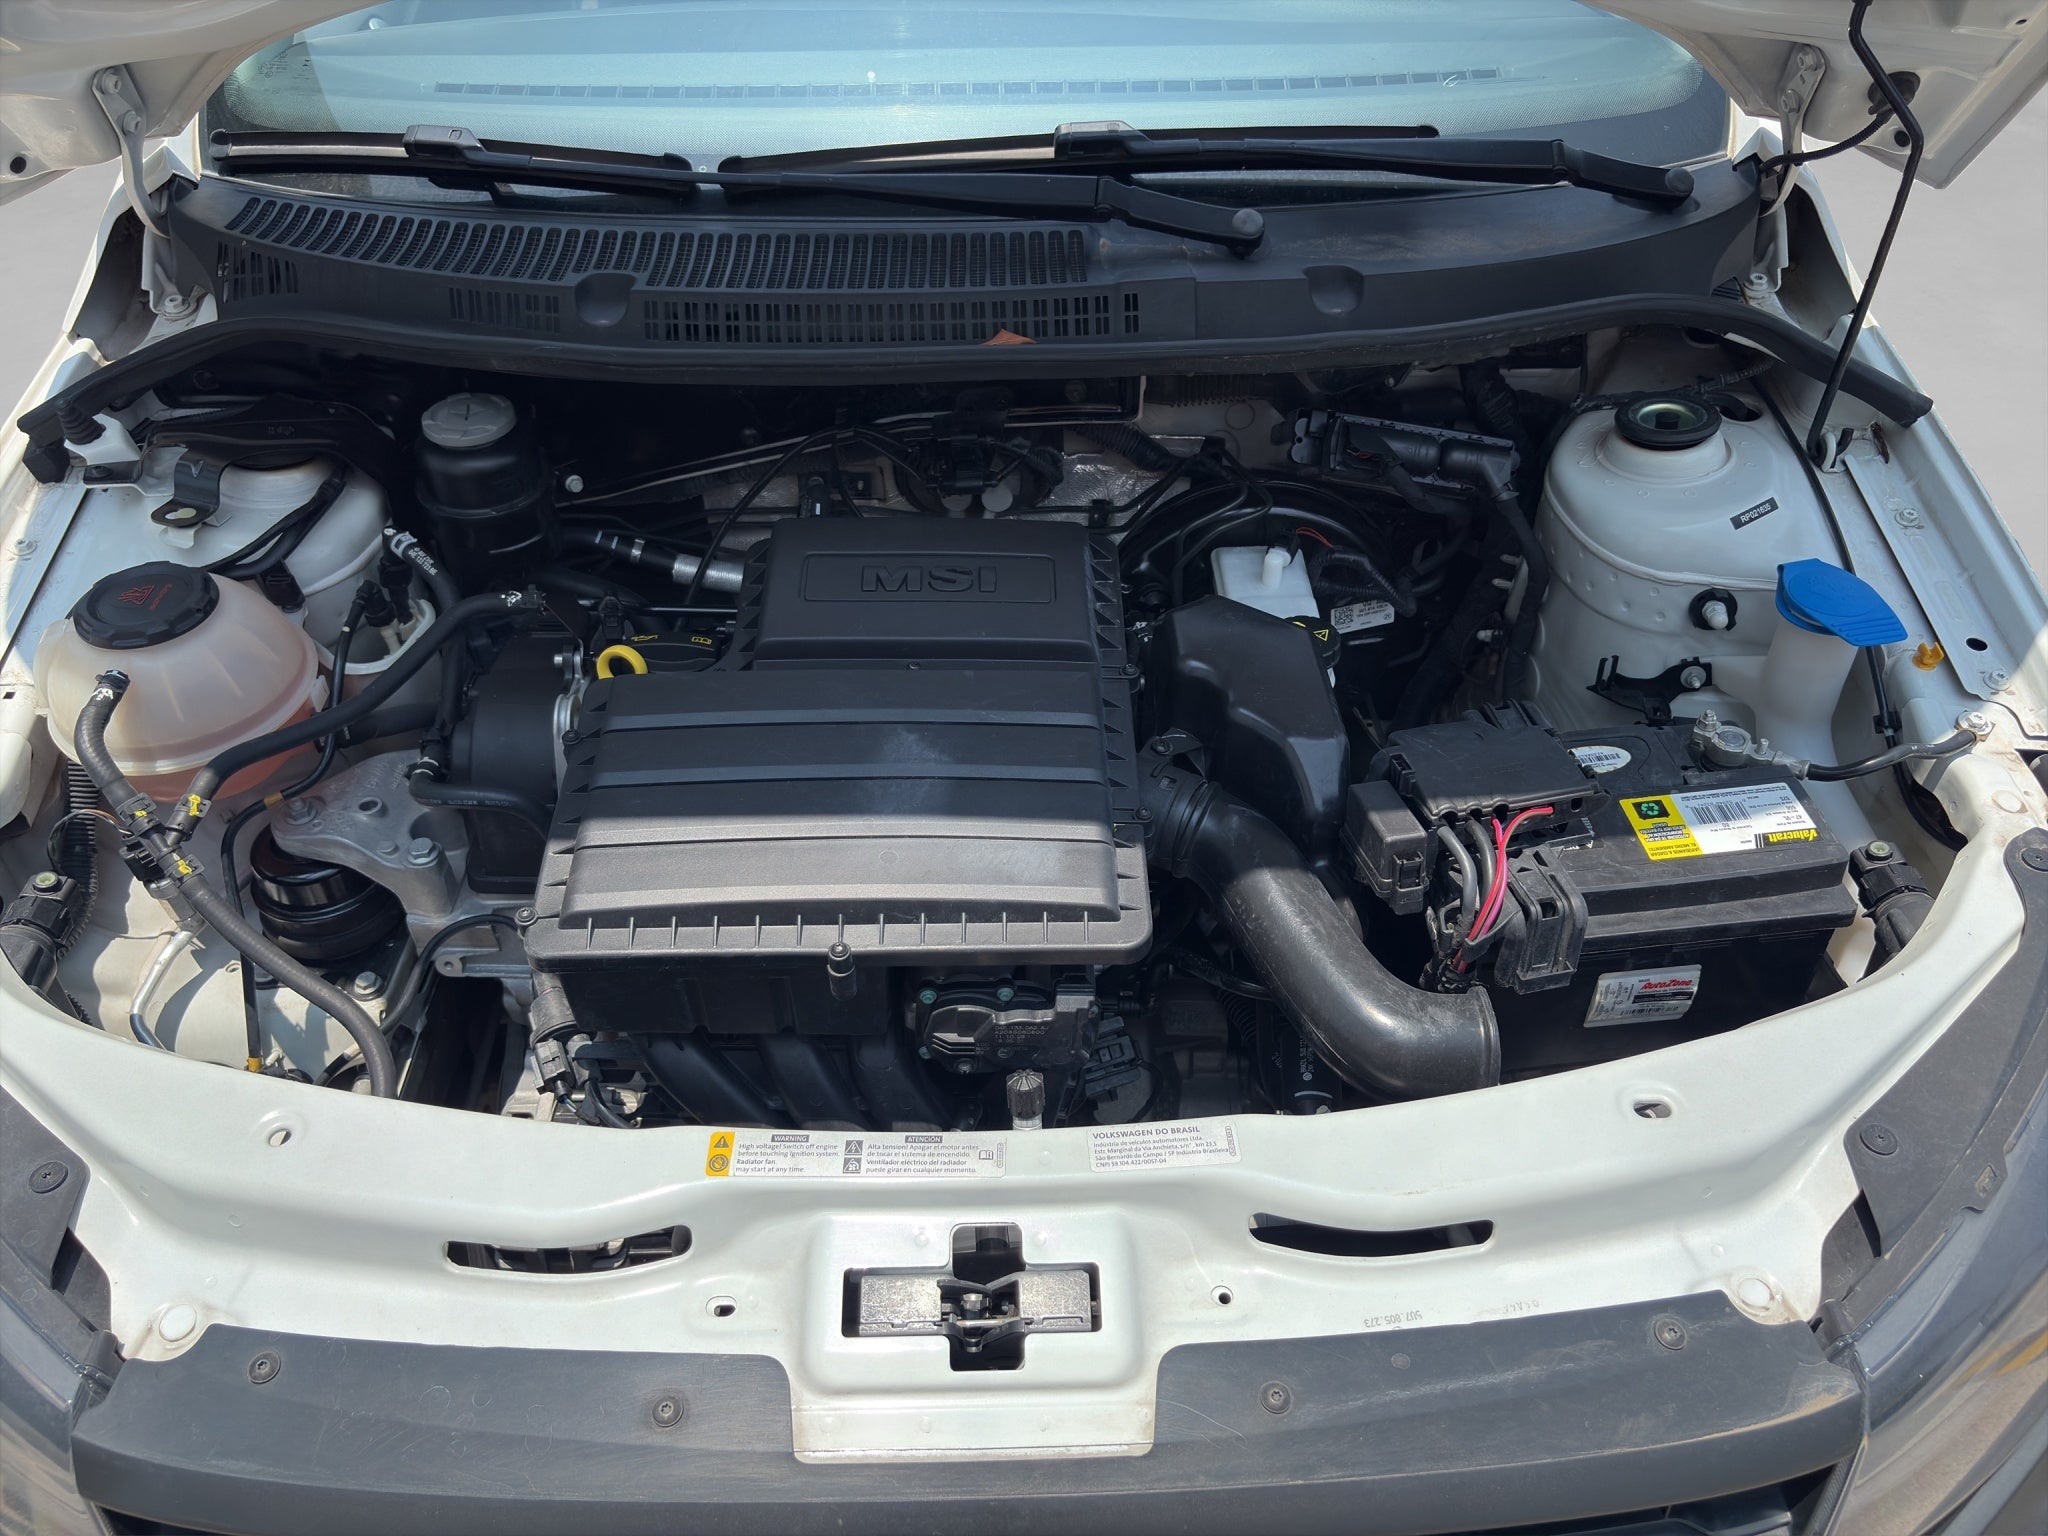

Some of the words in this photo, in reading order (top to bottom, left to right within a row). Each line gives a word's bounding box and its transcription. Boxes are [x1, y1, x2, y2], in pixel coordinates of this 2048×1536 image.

[861, 565, 998, 593] MSI
[1767, 828, 1818, 843] Valucraft
[1641, 978, 1693, 990] AutoZone
[1092, 1129, 1153, 1139] VOLKSWAGEN
[1170, 1126, 1201, 1134] BRASIL
[1363, 1310, 1423, 1328] 5U7.805.273
